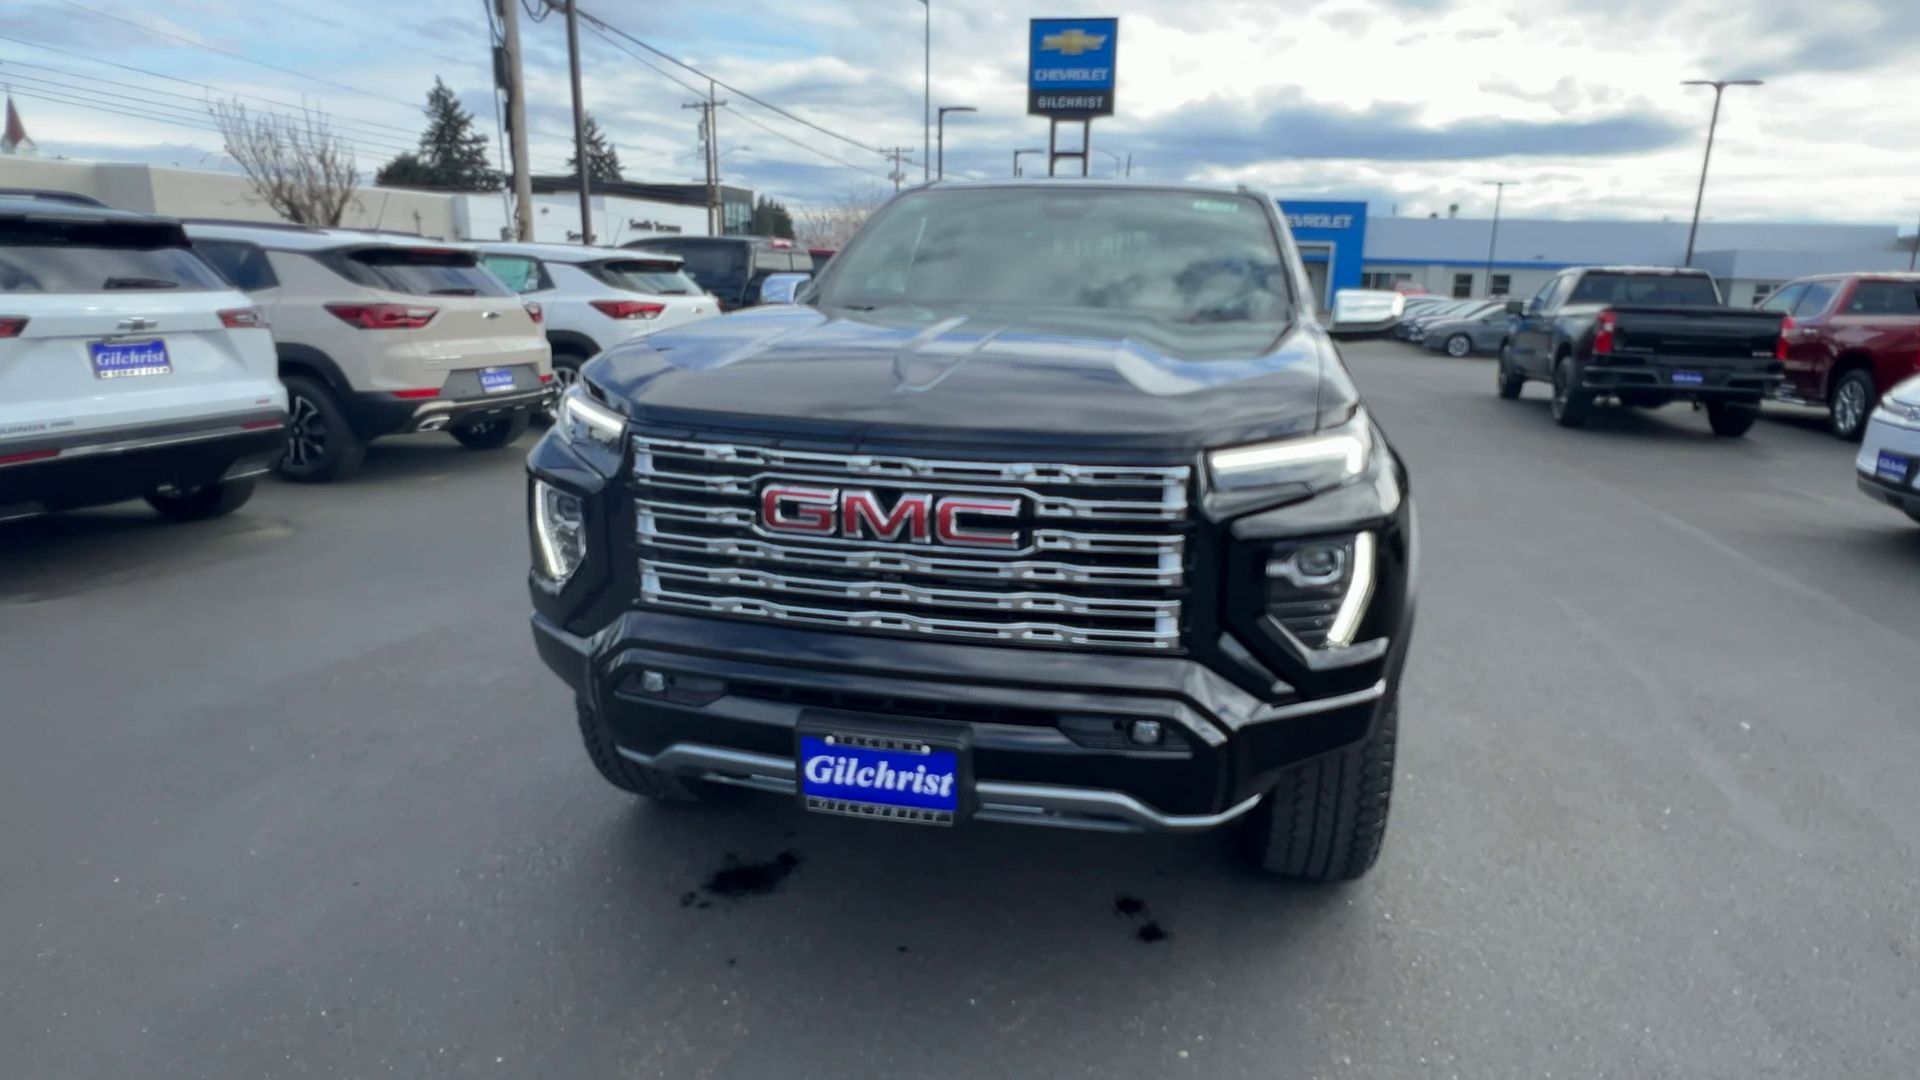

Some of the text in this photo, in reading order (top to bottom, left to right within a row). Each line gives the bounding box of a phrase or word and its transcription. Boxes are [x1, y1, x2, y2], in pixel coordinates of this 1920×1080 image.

[1034, 67, 1108, 82] CHEVROLET
[1038, 95, 1104, 109] GILCHRIST
[1287, 213, 1353, 228] EVROLET
[96, 349, 166, 367] Gilchrist
[760, 482, 1022, 550] GMC
[804, 754, 955, 798] Gilchrist
